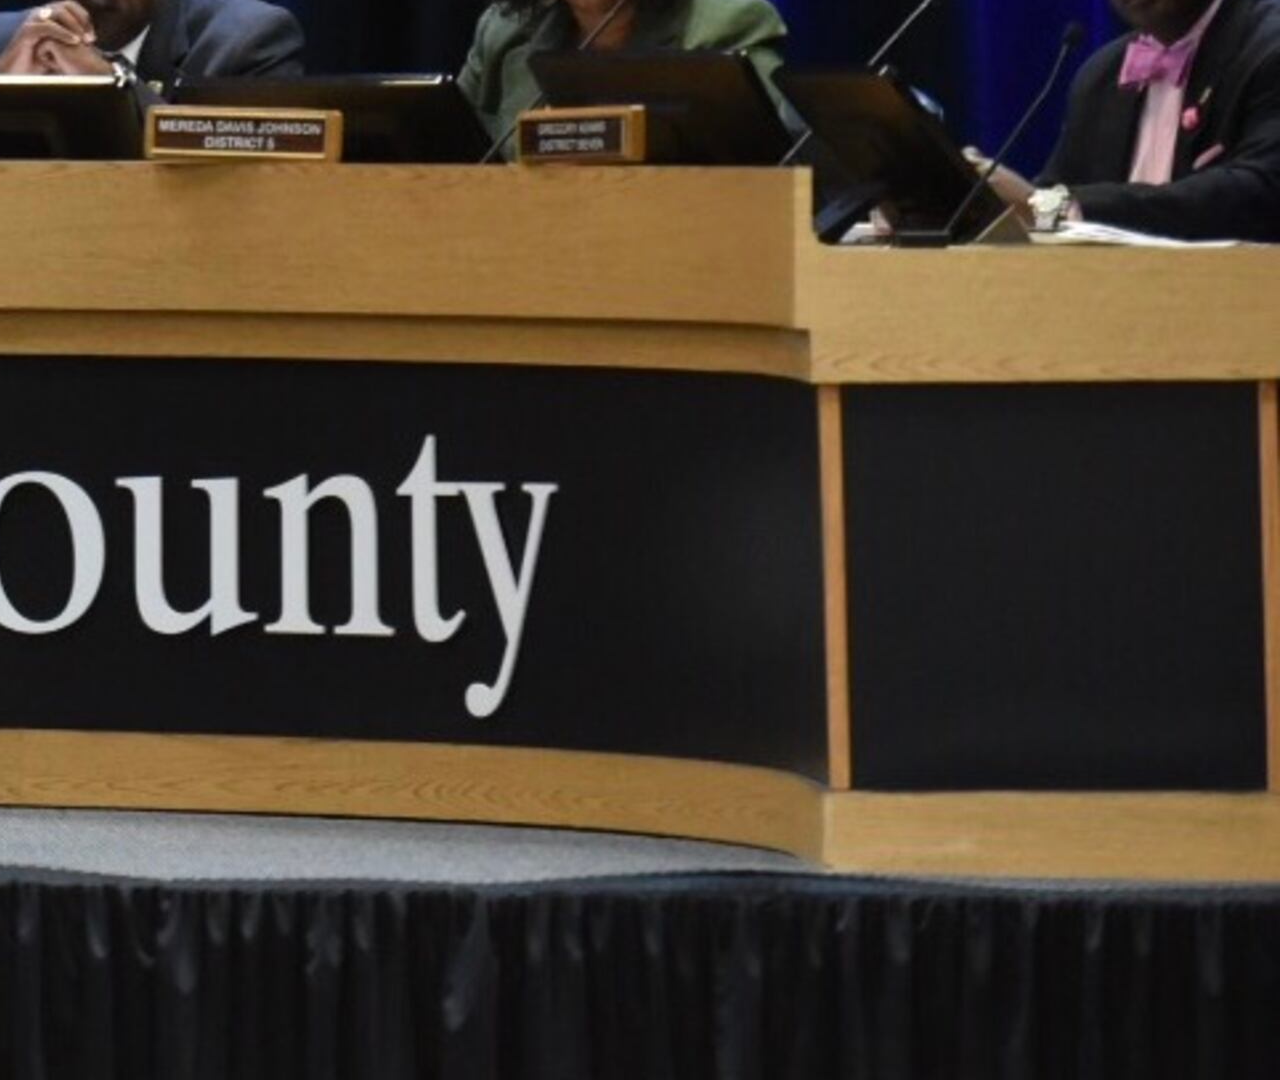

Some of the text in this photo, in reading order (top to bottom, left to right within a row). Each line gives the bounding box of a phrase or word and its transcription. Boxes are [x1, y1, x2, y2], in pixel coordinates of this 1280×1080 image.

[159, 119, 321, 136] MEREDA DAVIS JOHNSON
[204, 136, 264, 150] DISTRICT
